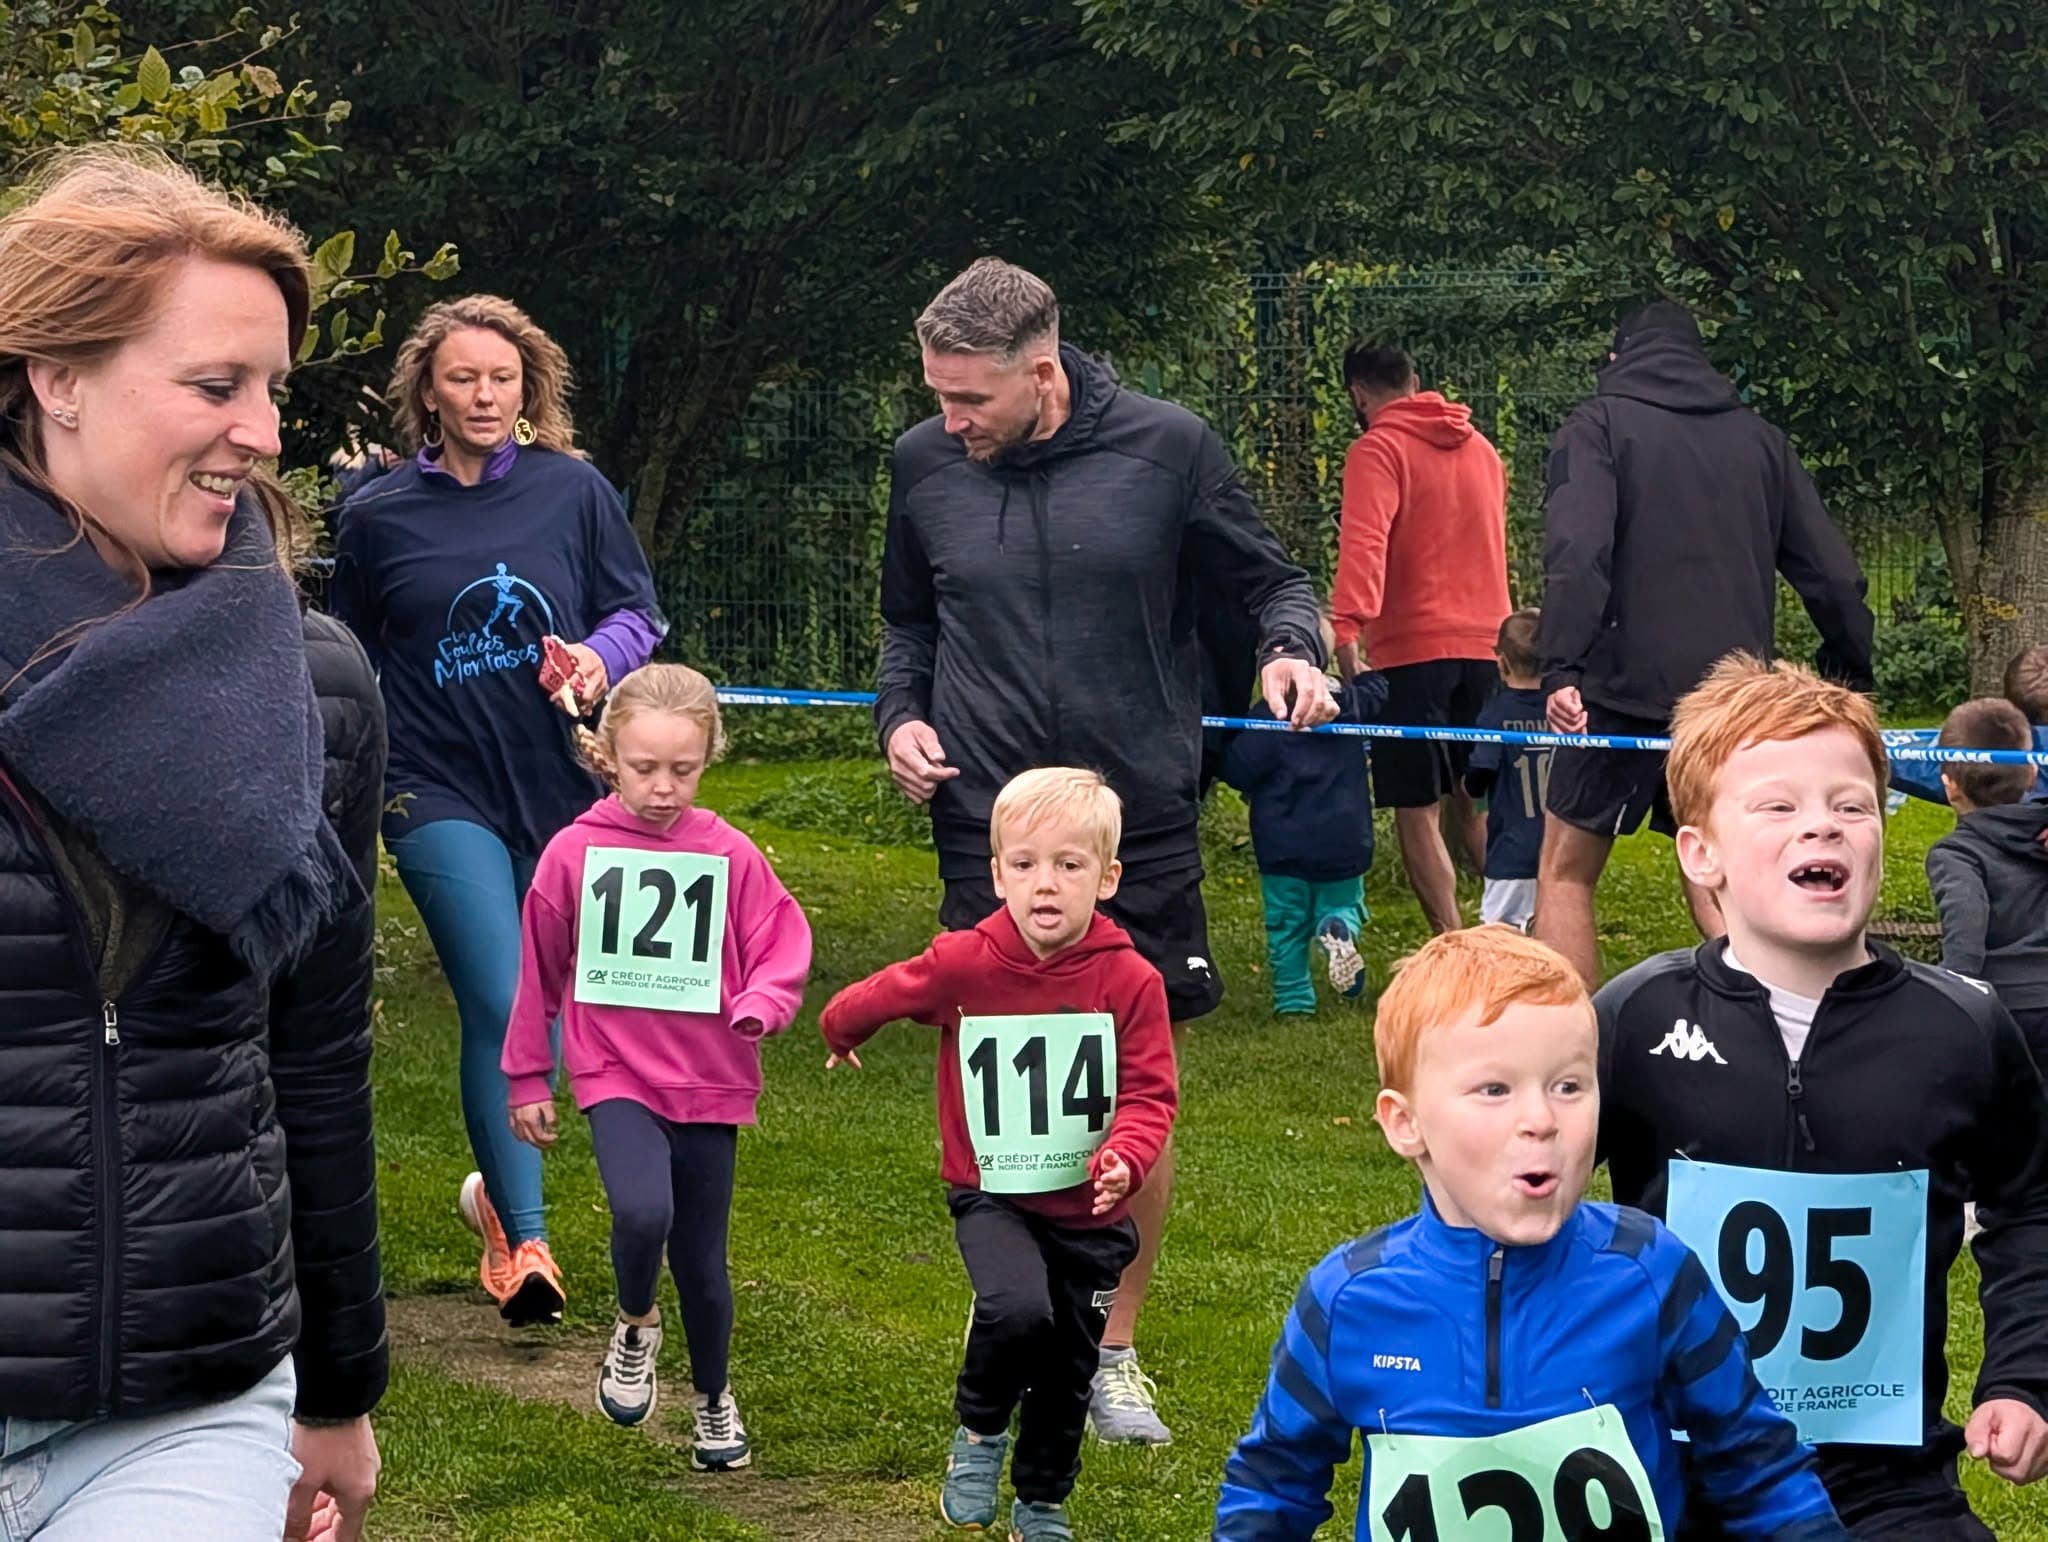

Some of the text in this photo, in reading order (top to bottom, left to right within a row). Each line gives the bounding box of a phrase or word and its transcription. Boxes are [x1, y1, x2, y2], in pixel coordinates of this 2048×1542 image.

[591, 866, 714, 963] 121
[611, 970, 653, 982] CRÉDIT
[656, 975, 711, 987] AGRICOLE
[611, 979, 686, 992] NORD DE FRANCE
[967, 1034, 1111, 1136] 114
[997, 1153, 1040, 1163] CRÉDIT
[1043, 1150, 1092, 1162] AGRICO
[998, 1160, 1079, 1171] NORD DE FRANCE
[1718, 1200, 1872, 1361] 95
[1373, 1354, 1421, 1372] KIPSTA
[1802, 1384, 1905, 1399] AGRICOLE
[1775, 1398, 1857, 1413] DE FRANCE
